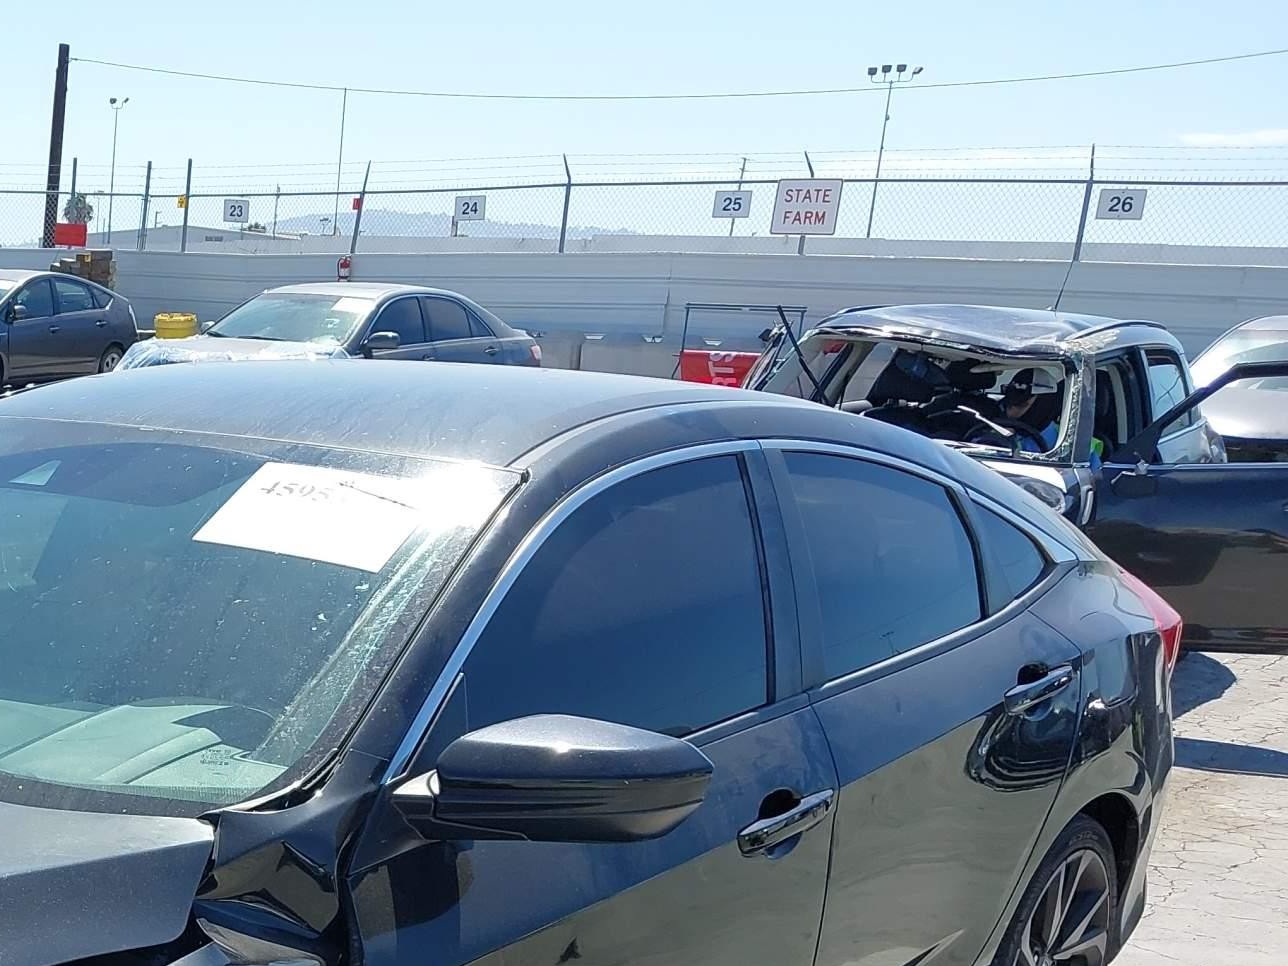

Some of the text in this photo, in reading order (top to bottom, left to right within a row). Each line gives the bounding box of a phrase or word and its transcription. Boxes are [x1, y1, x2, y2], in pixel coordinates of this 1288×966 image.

[784, 189, 832, 203] STATE
[229, 204, 243, 217] 23
[462, 201, 478, 215] 24
[722, 197, 742, 211] 25
[1108, 196, 1134, 212] 26
[782, 211, 826, 225] FARM
